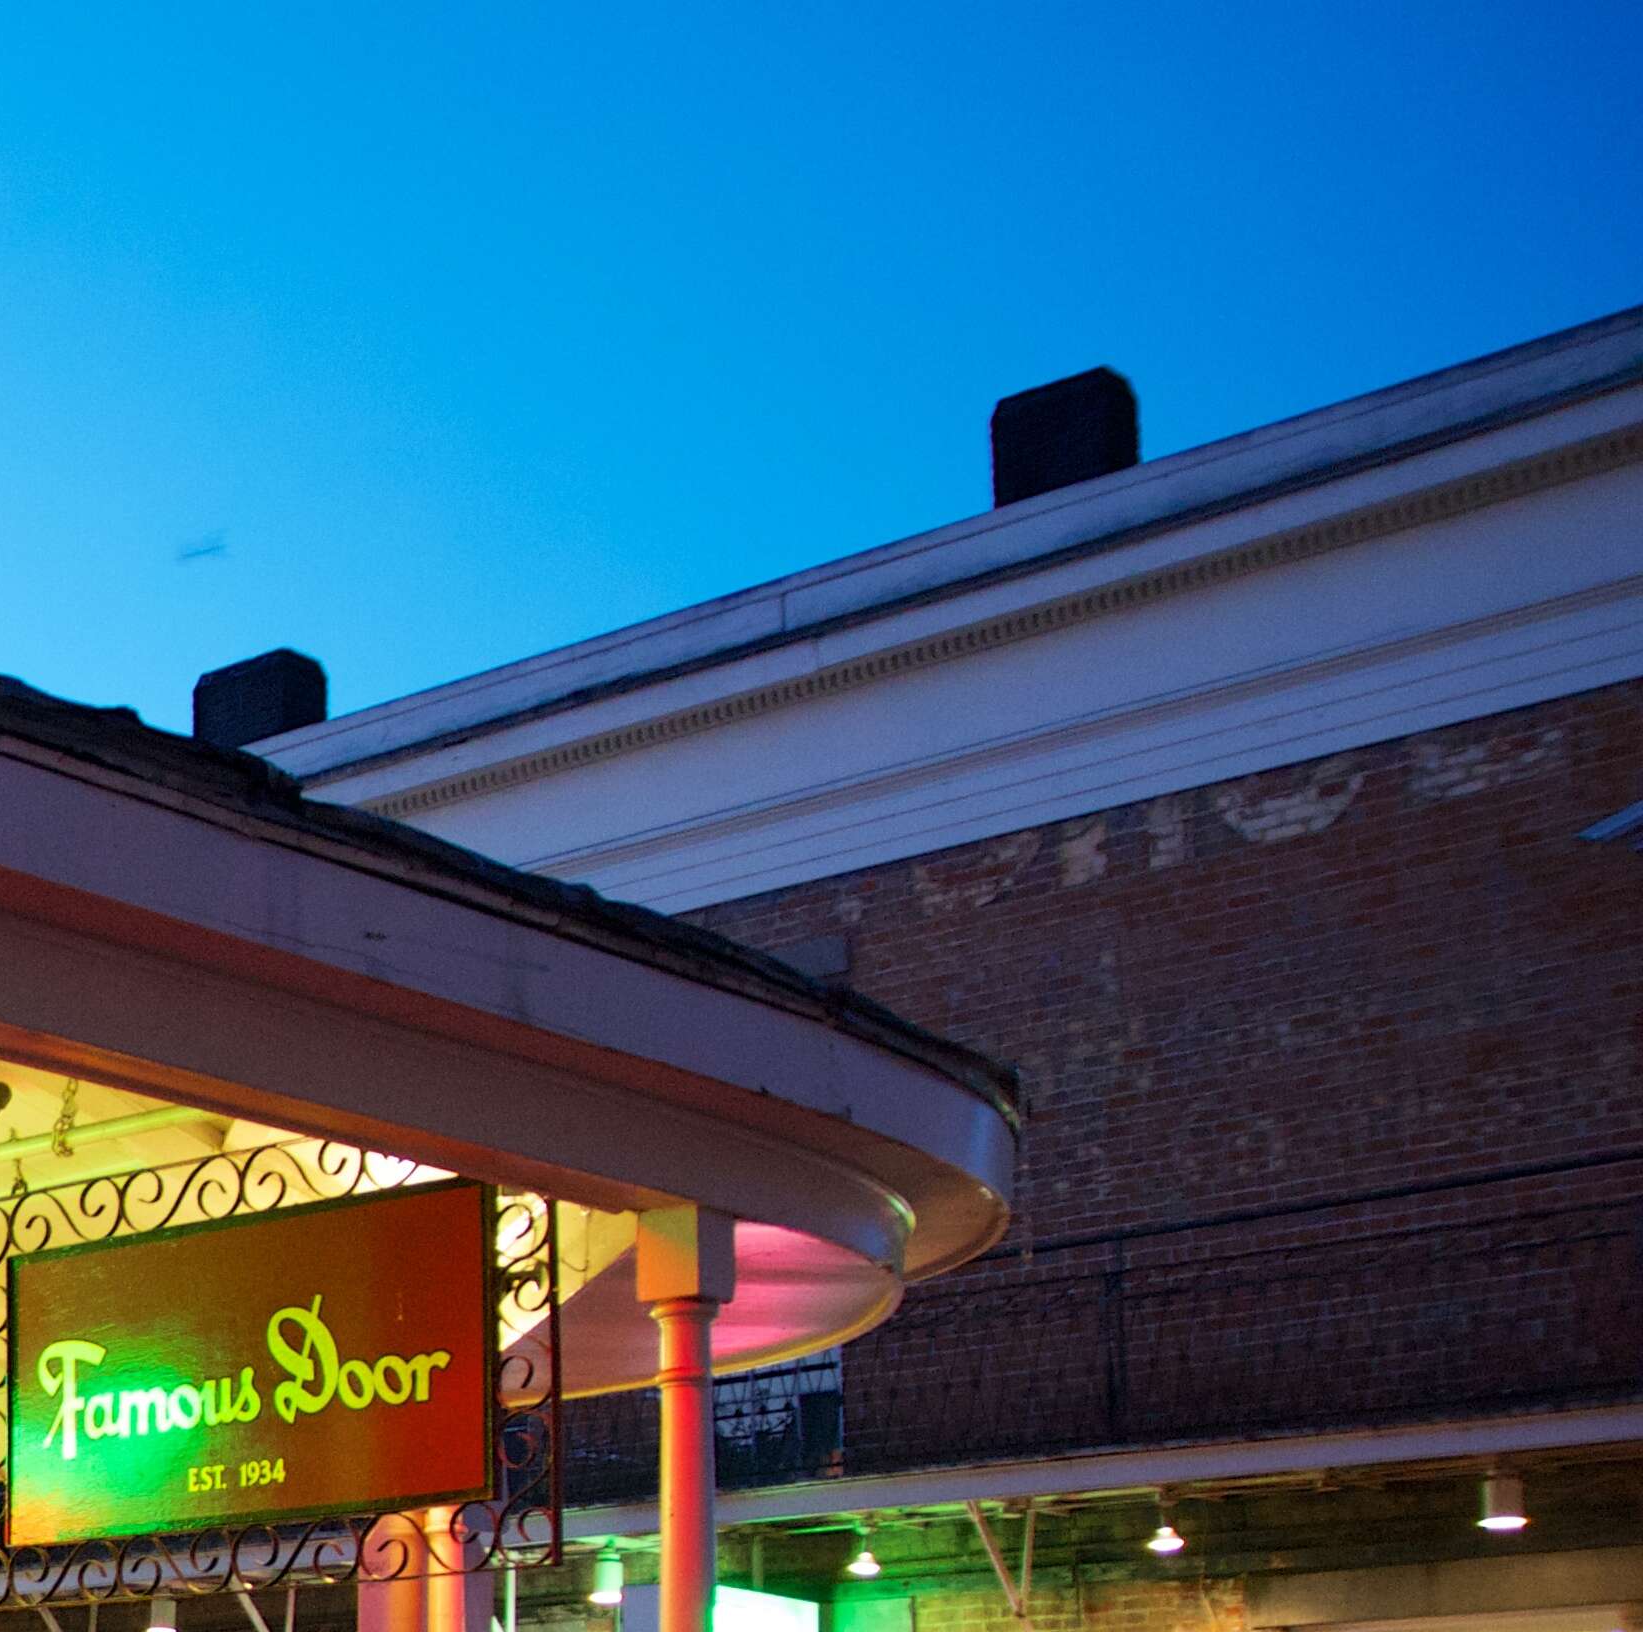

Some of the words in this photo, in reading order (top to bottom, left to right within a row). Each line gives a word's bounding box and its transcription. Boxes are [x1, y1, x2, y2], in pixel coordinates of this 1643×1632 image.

[37, 1339, 262, 1461] Famous
[266, 1293, 451, 1424] Door
[187, 1464, 227, 1493] EST.
[239, 1457, 286, 1487] 1934
